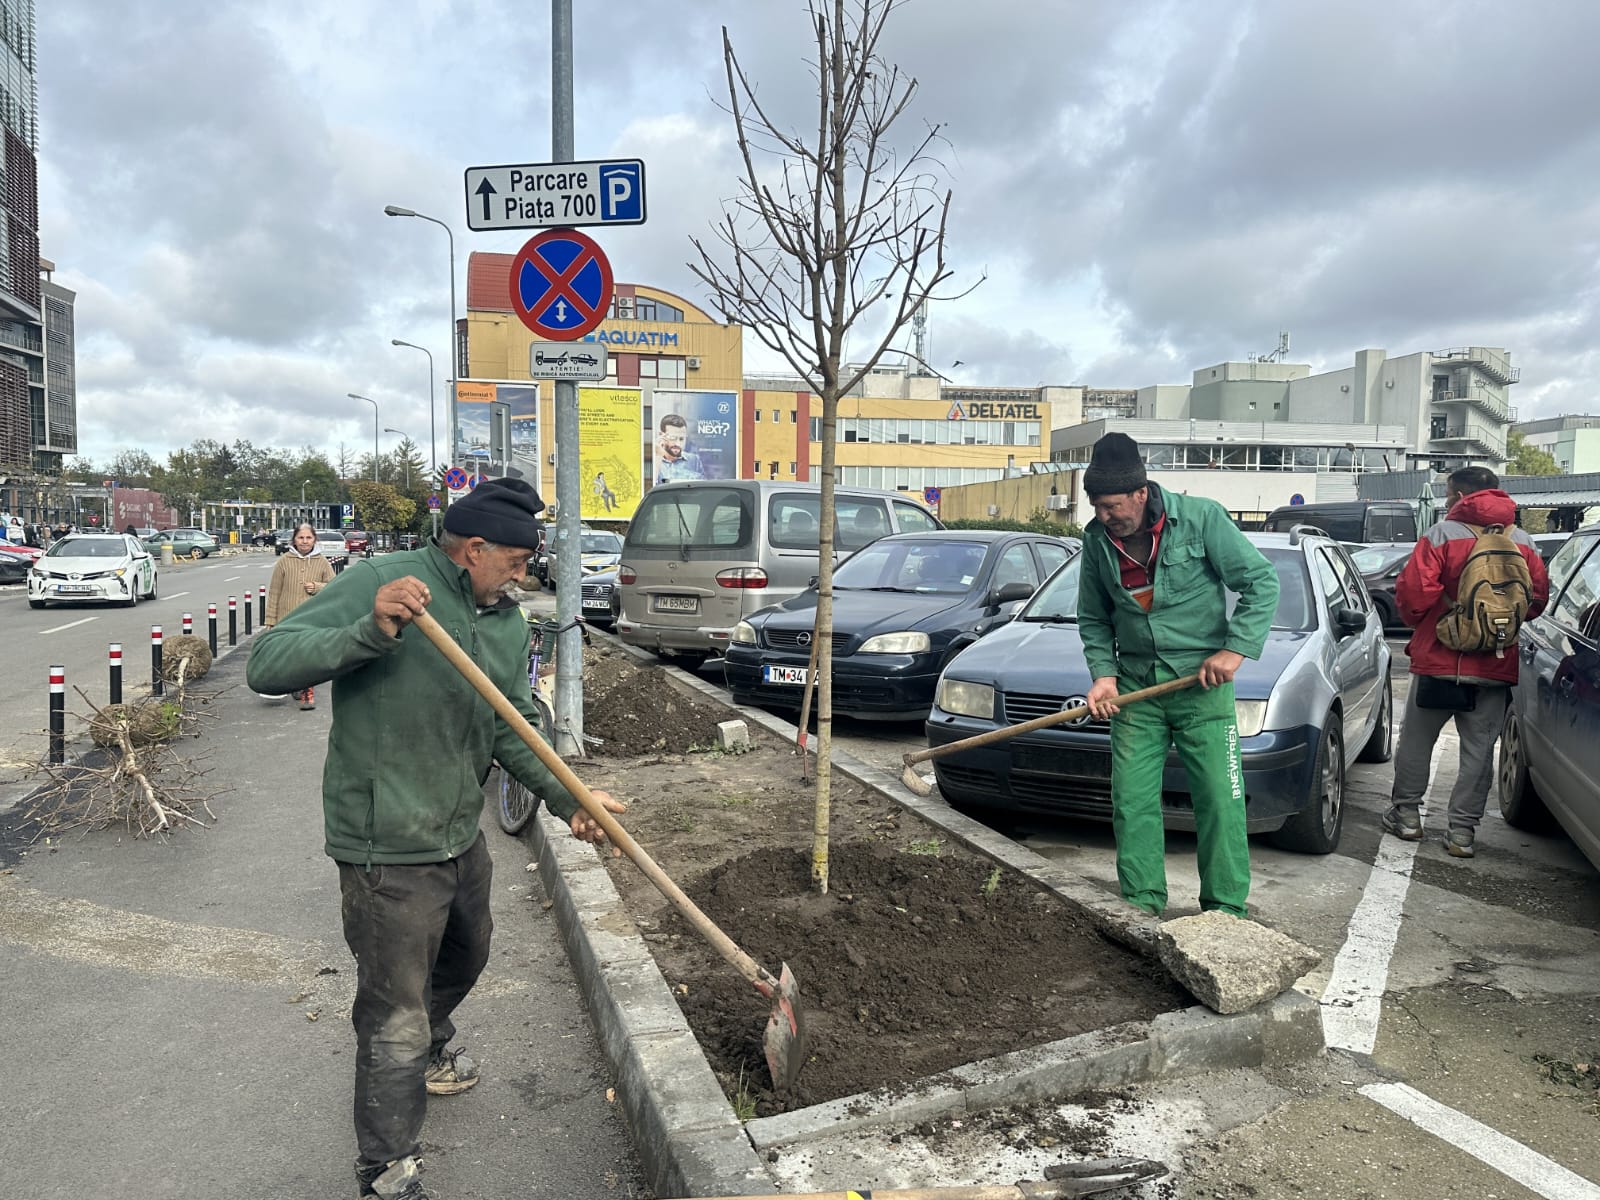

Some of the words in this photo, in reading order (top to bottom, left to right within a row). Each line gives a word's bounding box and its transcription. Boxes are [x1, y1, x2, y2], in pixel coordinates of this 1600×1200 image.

[510, 170, 588, 193] Parcare
[609, 177, 632, 216] P
[505, 197, 555, 223] Piața
[560, 194, 596, 217] 700
[595, 330, 678, 347] AQUATIM
[969, 402, 1042, 419] DELTATEL
[698, 422, 730, 437] NEXT?
[772, 668, 786, 681] TM
[790, 669, 802, 682] 34
